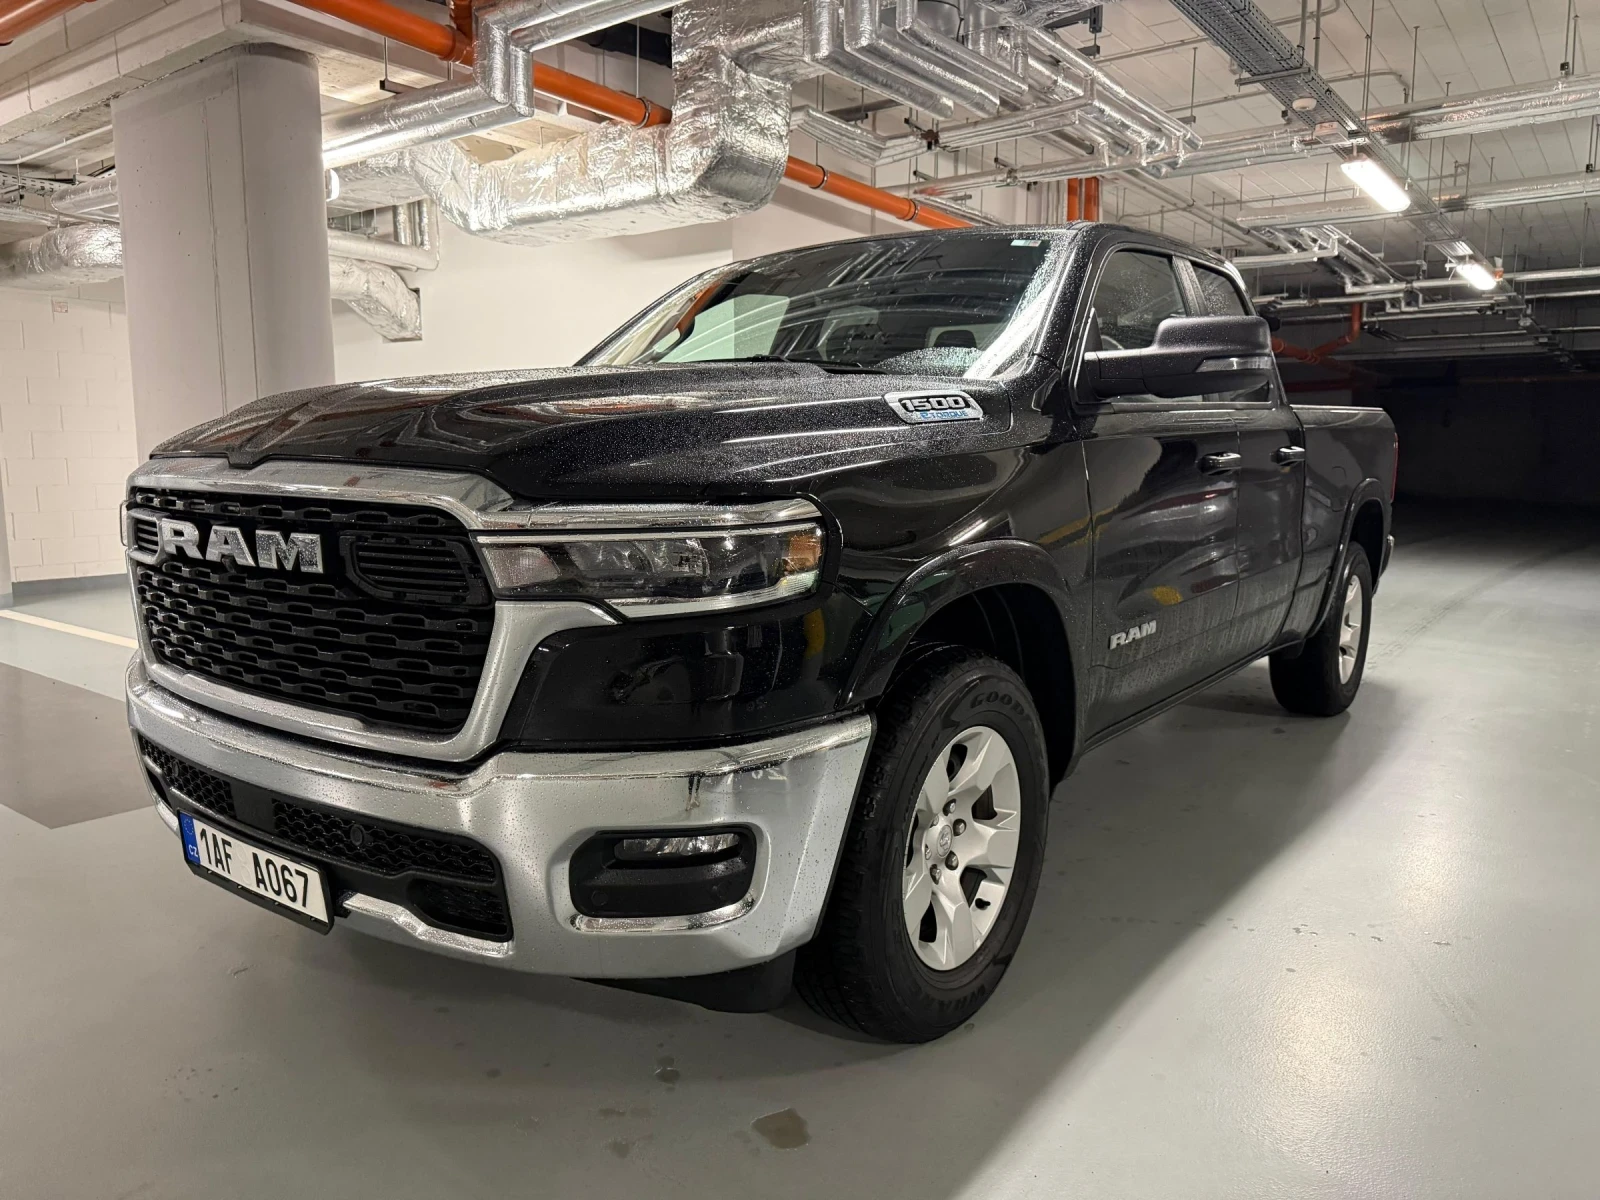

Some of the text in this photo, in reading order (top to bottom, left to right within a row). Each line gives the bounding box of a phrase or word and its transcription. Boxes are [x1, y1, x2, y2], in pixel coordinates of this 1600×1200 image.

[901, 396, 966, 411] 1500
[161, 518, 324, 574] RAM
[1109, 620, 1157, 650] RAM
[188, 844, 199, 858] CZ
[200, 828, 309, 908] 1AF A067
